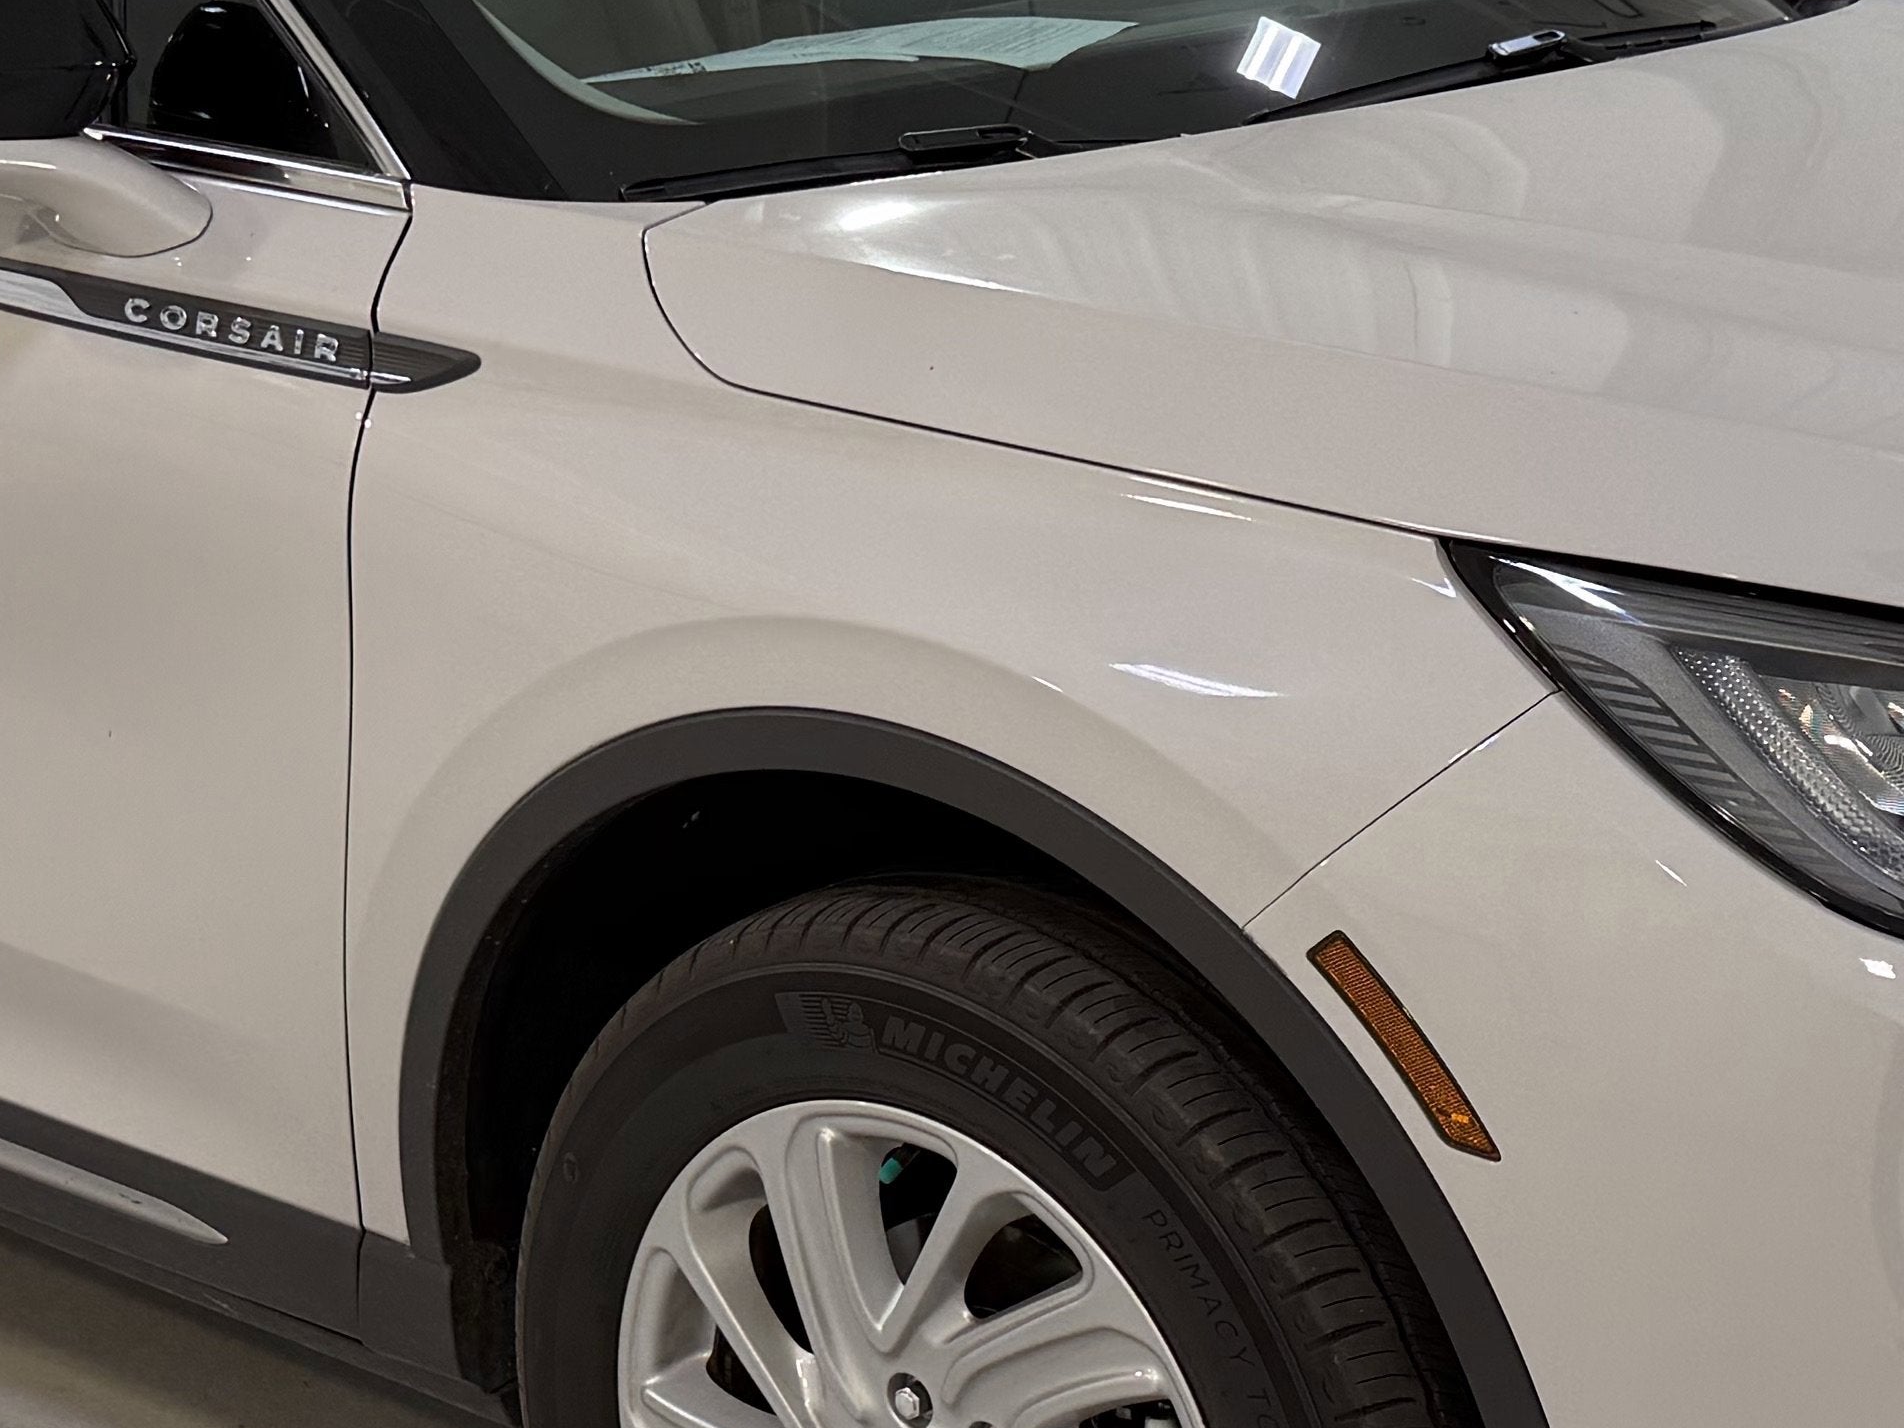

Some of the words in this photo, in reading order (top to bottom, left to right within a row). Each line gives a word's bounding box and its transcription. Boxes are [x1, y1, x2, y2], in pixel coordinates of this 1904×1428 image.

[124, 297, 339, 362] CORSAIR
[880, 1013, 1120, 1179] MICHELIN
[1141, 1208, 1256, 1370] PRIMACY
